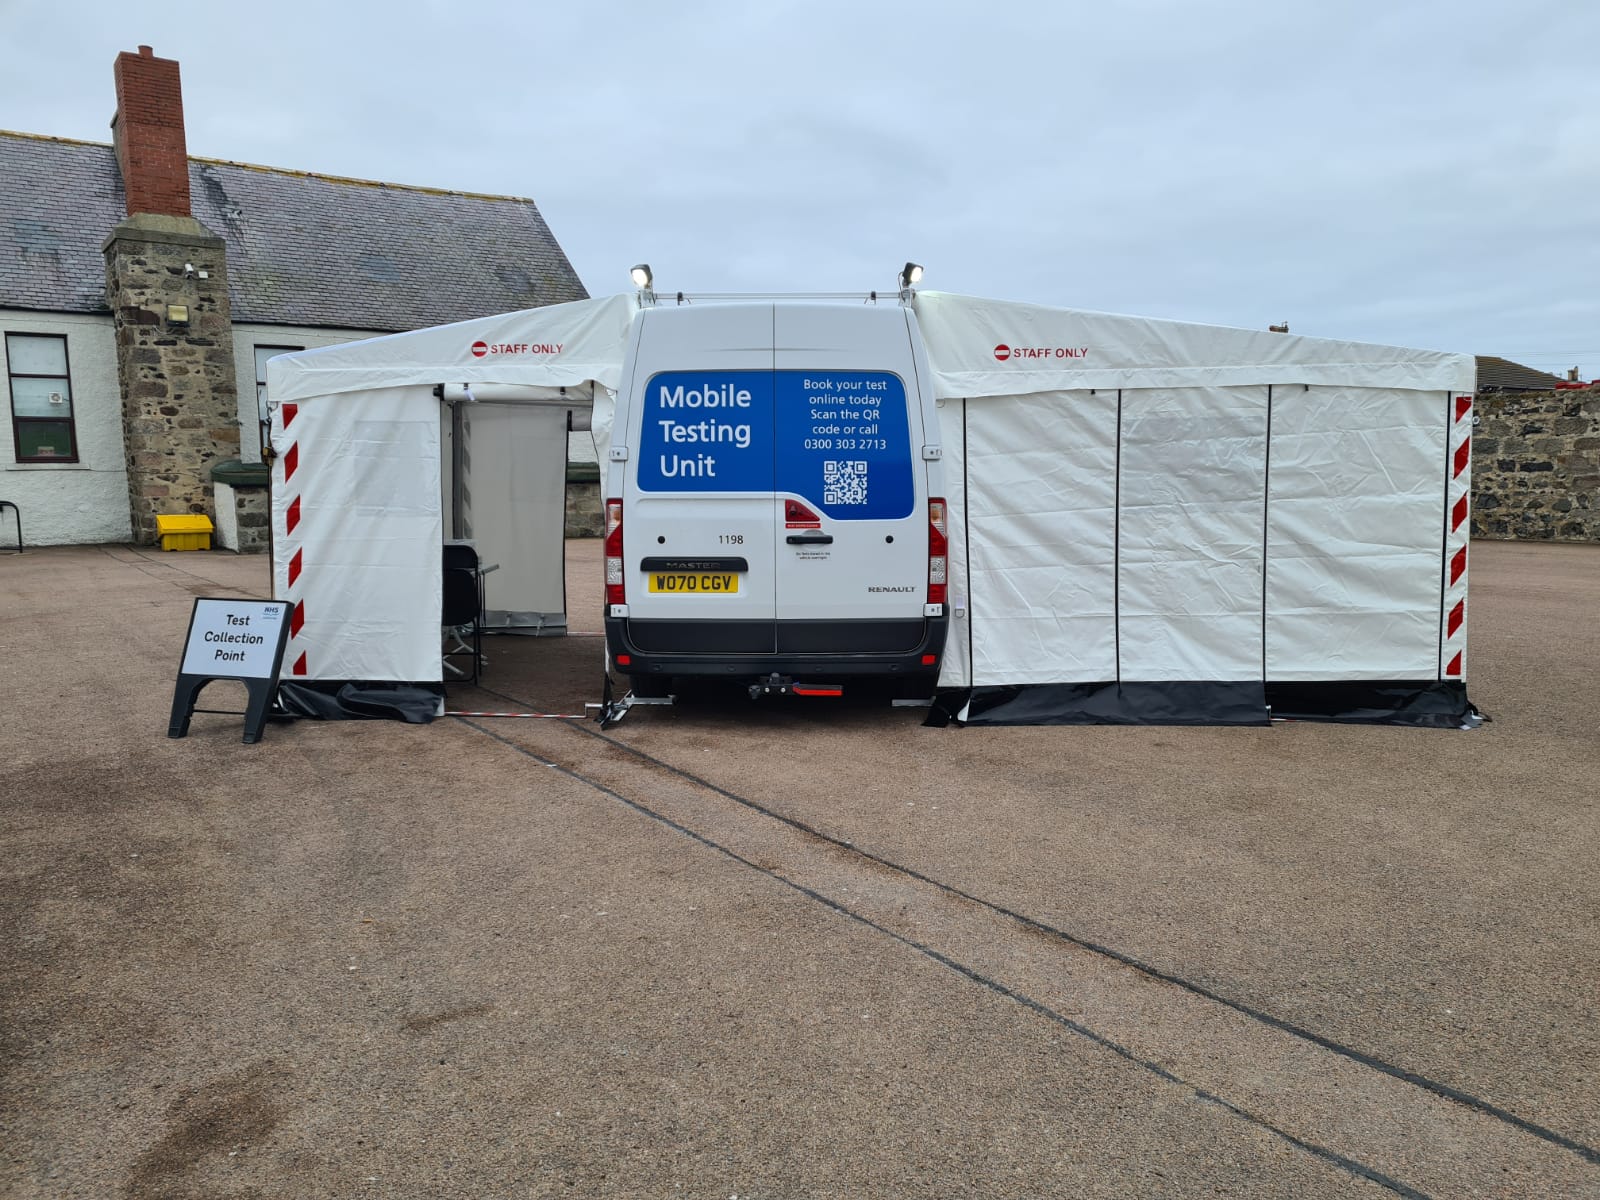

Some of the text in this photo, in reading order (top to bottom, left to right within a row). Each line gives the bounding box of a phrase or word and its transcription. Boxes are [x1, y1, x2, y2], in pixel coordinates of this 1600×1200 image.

[490, 343, 564, 354] STAFF ONLY
[1013, 347, 1088, 358] STAFF ONLY
[803, 378, 888, 392] Book your test
[659, 383, 752, 408] Mobile
[809, 393, 882, 407] online today
[810, 408, 880, 421] Scan the QR
[657, 418, 751, 448] Testing
[812, 424, 878, 434] code or call
[804, 439, 887, 449] 0300 303 2713
[660, 453, 716, 477] Unit
[718, 534, 744, 545] 1198
[665, 561, 721, 569] MASTER
[701, 575, 732, 590] CGV
[226, 614, 250, 626] Test
[204, 631, 264, 645] Collection
[214, 649, 246, 662] Point
